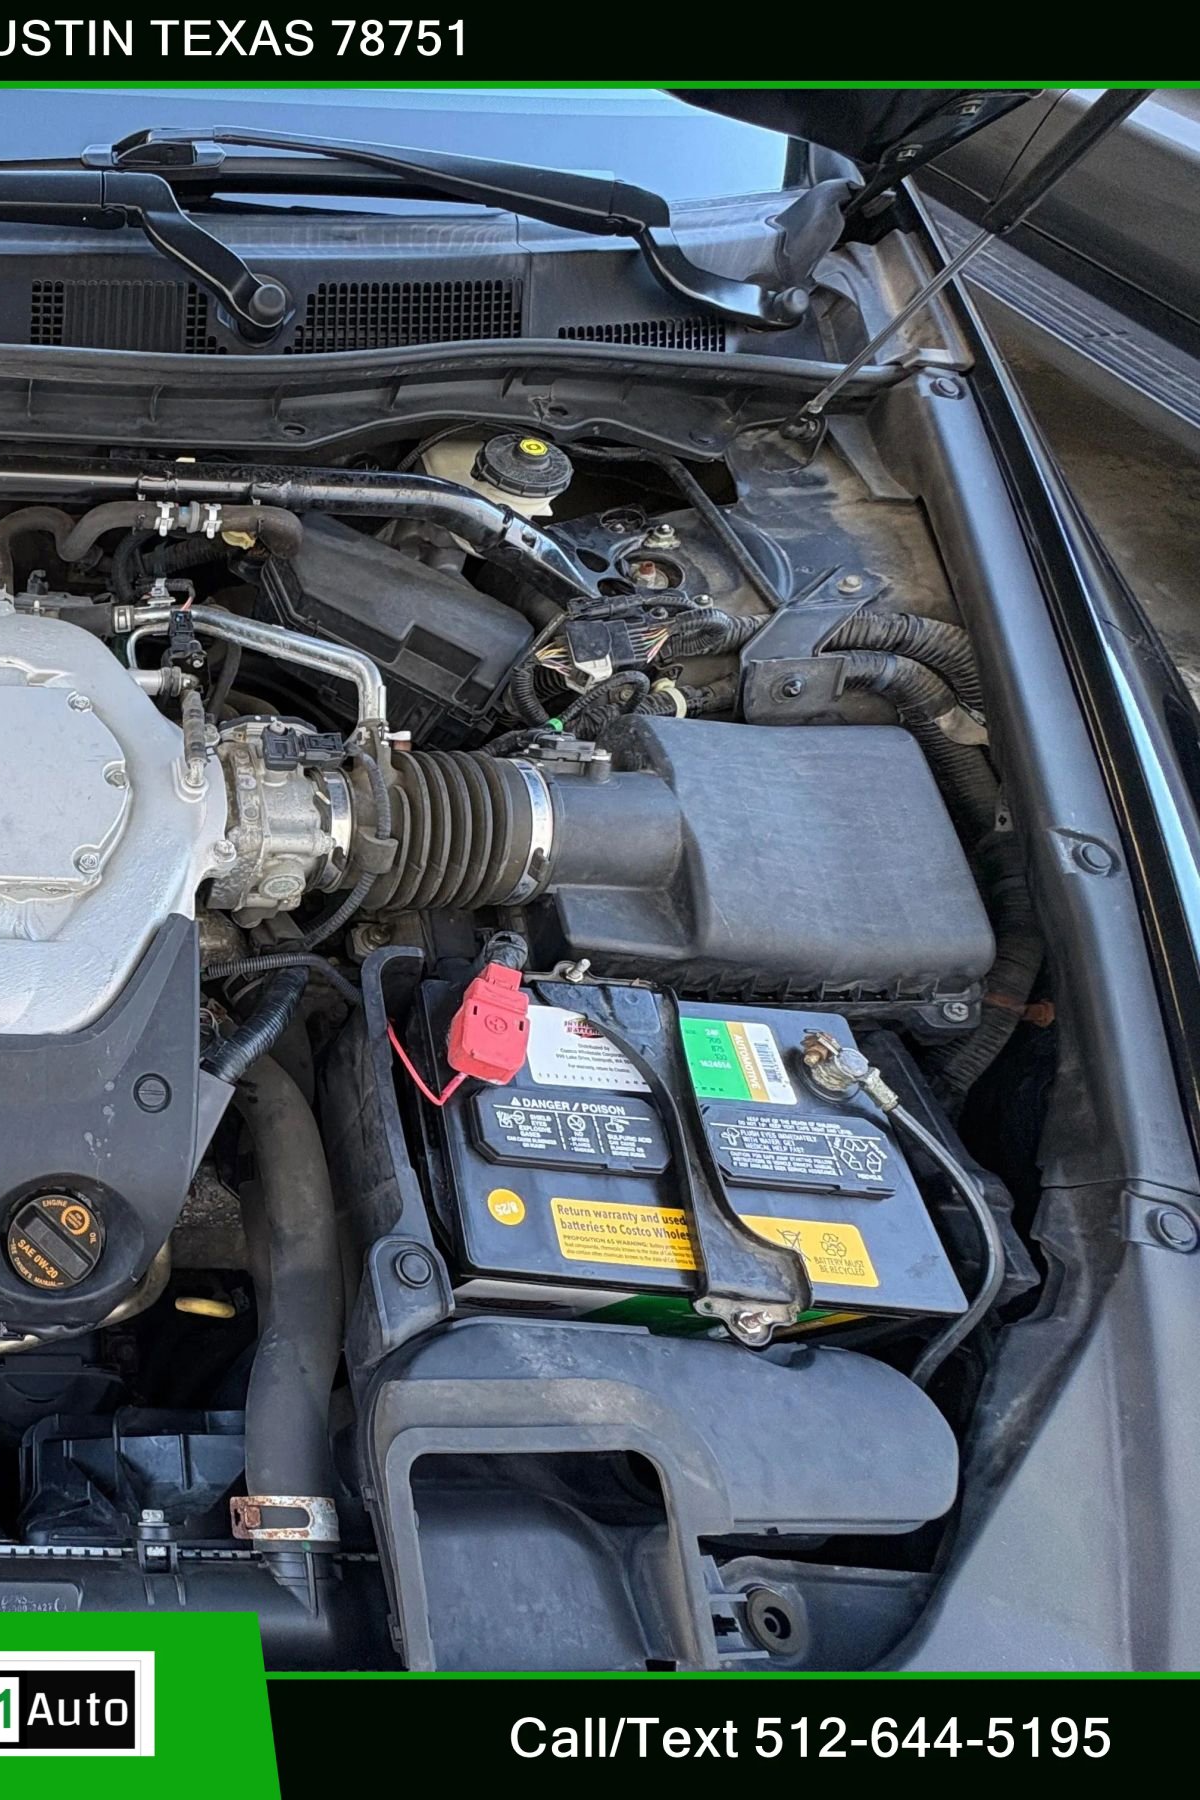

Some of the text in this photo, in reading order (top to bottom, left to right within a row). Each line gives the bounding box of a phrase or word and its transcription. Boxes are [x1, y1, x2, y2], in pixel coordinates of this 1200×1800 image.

[734, 1034, 761, 1090] AUTOMOTIVE
[522, 1097, 570, 1111] DANGER
[581, 1103, 626, 1116] POISON
[740, 1129, 817, 1143] FLUSH EYES IMMEDIATELY
[742, 1135, 759, 1143] WITH
[744, 1142, 771, 1151] MEDICAL
[42, 1199, 68, 1208] ENGINE
[557, 1204, 686, 1226] Return warranty and used
[560, 1218, 605, 1232] batteries
[606, 1224, 618, 1234] to
[619, 1225, 653, 1237] Costco
[89, 1232, 97, 1244] OIL
[563, 1234, 606, 1244] PROPOSITION
[17, 1239, 59, 1279] SAE 0W-20
[814, 1256, 865, 1268] BATTERY MUST
[819, 1265, 865, 1276] BE RECYCLED
